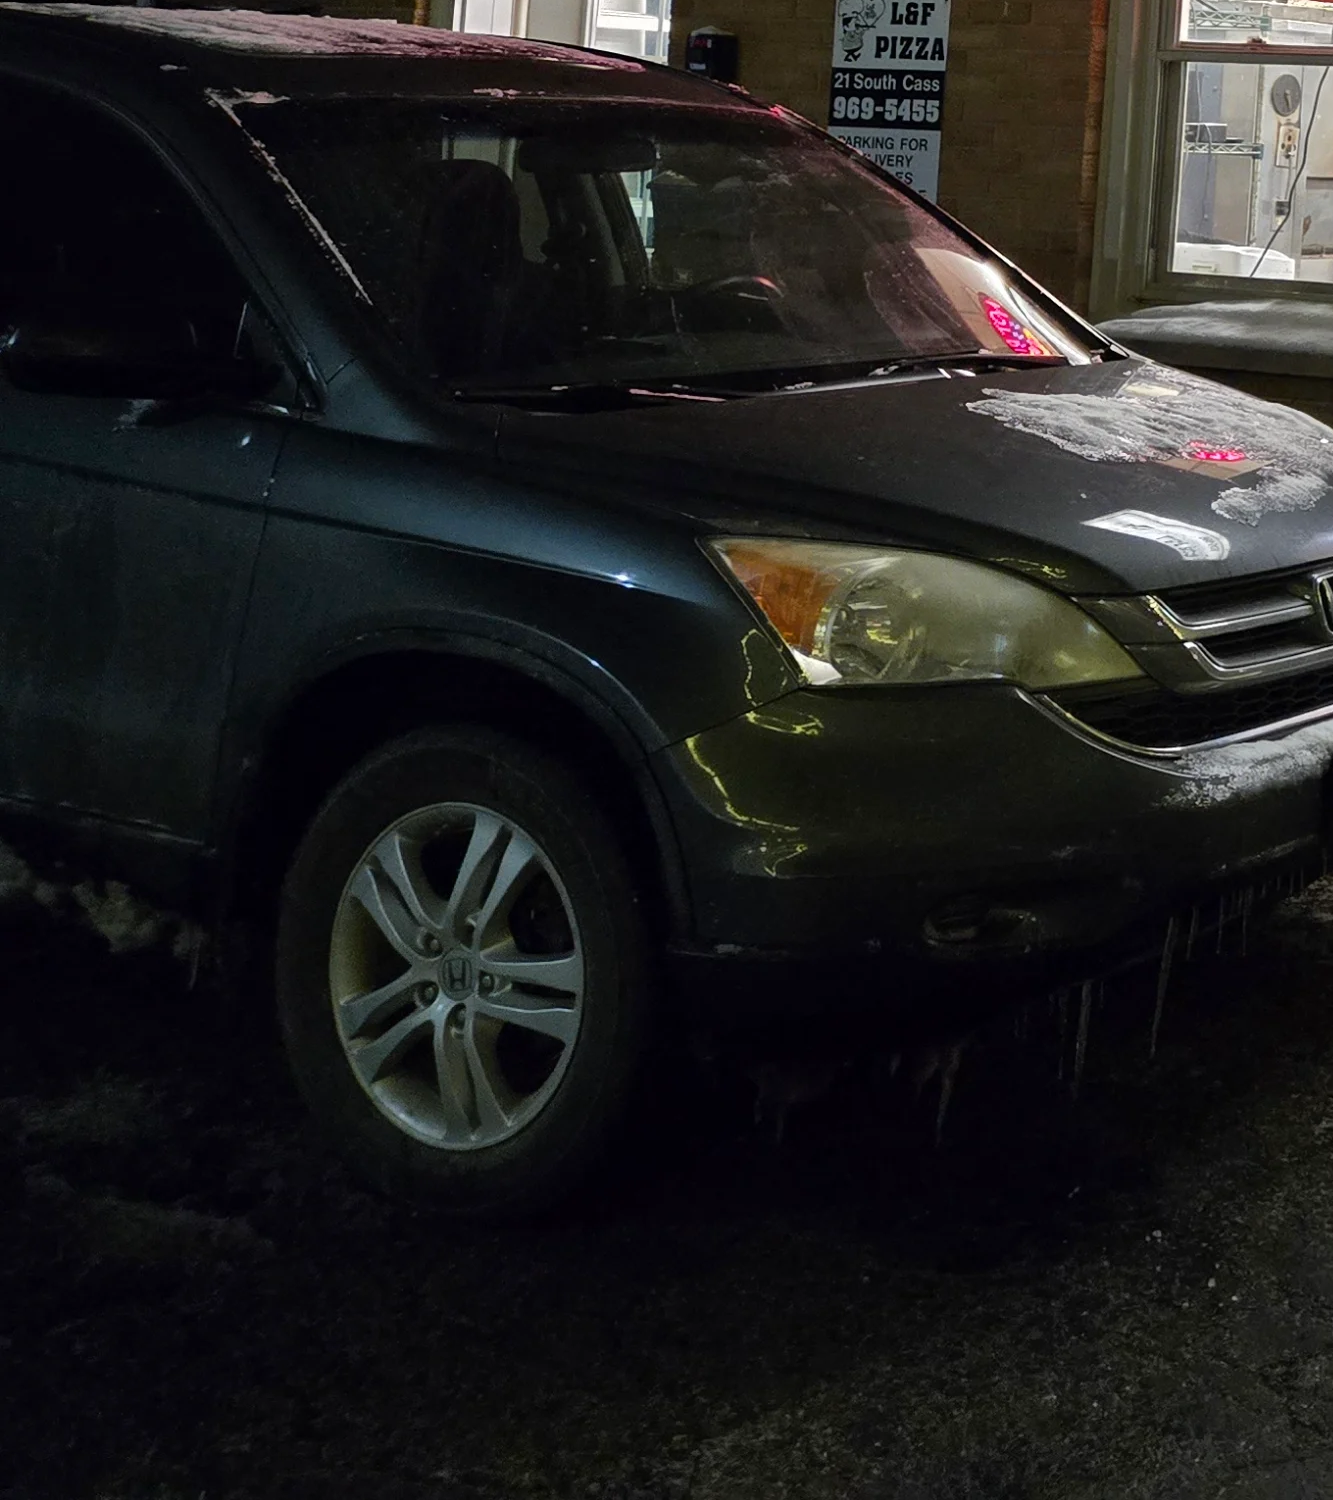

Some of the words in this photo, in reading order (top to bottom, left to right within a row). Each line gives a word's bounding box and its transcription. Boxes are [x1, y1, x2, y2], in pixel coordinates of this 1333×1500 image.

[890, 1, 935, 26] L&F
[874, 35, 945, 61] PIZZA
[833, 72, 850, 88] 21
[853, 73, 896, 90] South
[902, 74, 940, 92] Cass
[832, 95, 940, 123] 969-5455
[900, 138, 928, 151] FOR
